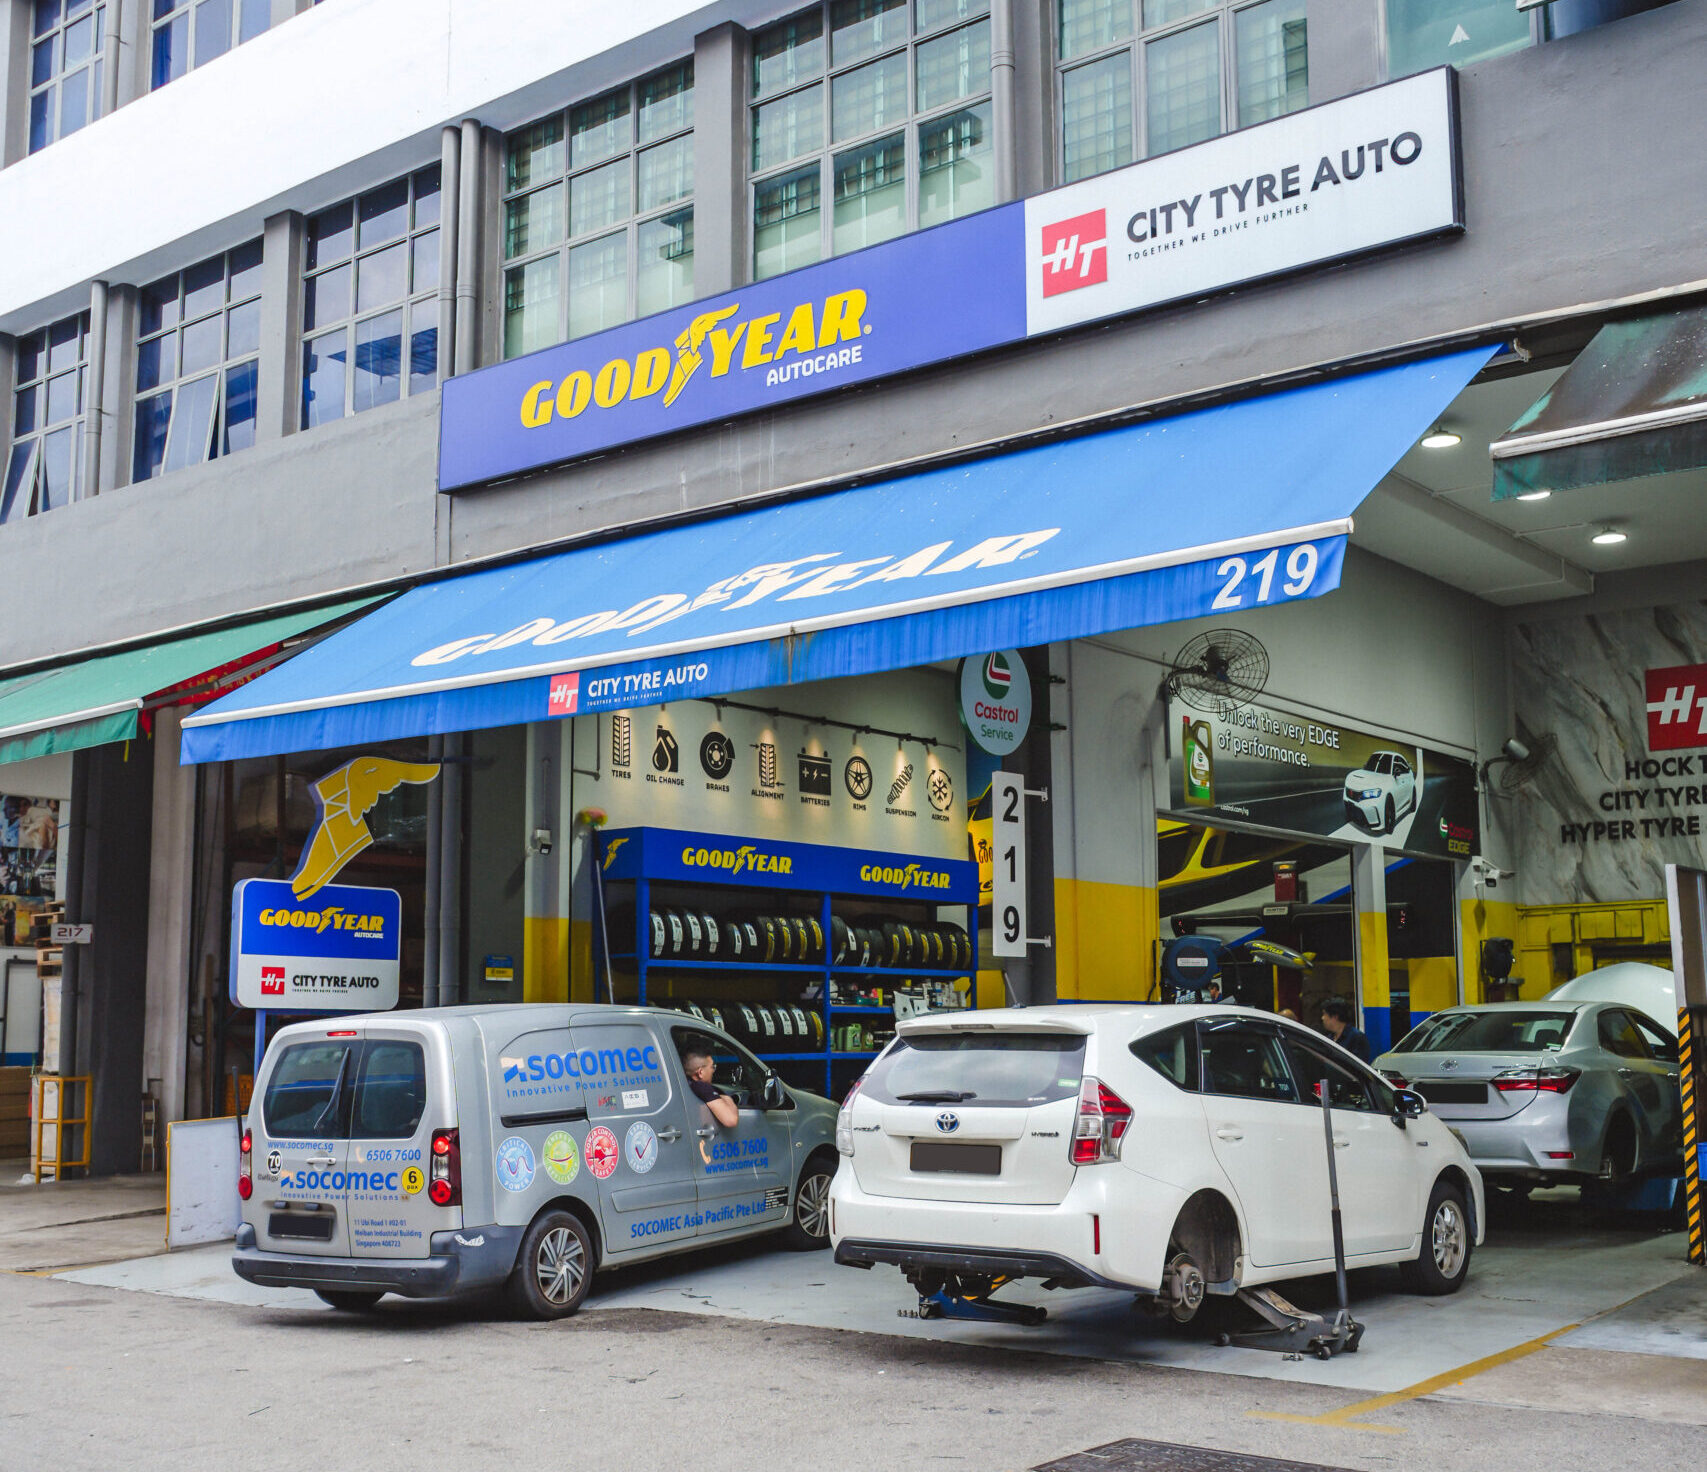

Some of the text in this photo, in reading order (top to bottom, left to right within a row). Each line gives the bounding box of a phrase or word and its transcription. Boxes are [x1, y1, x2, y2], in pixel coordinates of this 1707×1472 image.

[1126, 131, 1423, 243] CITY TYRE AUTO
[1128, 204, 1309, 261] TOGETHER WE DRIVE FURTHER
[520, 289, 868, 428] GOODYEAR
[766, 345, 863, 387] AUTOCARE
[1211, 543, 1318, 610] 219
[411, 528, 1061, 667] GOODYEAR
[588, 663, 709, 698] CITY TYRE AUTO
[974, 700, 1019, 724] Castrol
[981, 724, 1014, 741] Service
[1217, 701, 1340, 749] Unlock the very EDGE
[1218, 729, 1311, 767] of performance.
[612, 769, 632, 779] TIRES
[646, 774, 685, 786] OIL CHANGE
[1625, 756, 1694, 781] HOCK
[706, 782, 730, 793] BRAKES
[751, 789, 785, 800] ALIGNMENT
[800, 796, 831, 807] BATTERIES
[853, 803, 867, 811] RIMS
[1600, 788, 1651, 811] CITY
[885, 807, 917, 818] SUSPENSION
[931, 813, 950, 822] AIRCON
[1561, 816, 1700, 843] HYPER TYRE
[1448, 838, 1470, 854] EDGE
[682, 846, 793, 875] GOODYEAR
[1003, 785, 1020, 943] 219
[860, 864, 950, 889] GOODYEAR
[259, 907, 385, 933] GOODYEAR
[57, 927, 83, 937] 217
[292, 975, 379, 988] CITY TYRE AUTO
[527, 1046, 658, 1080] socomec
[507, 1074, 663, 1099] Innovative Power Solutions
[267, 1141, 333, 1152] www.socomec.sg
[366, 1149, 421, 1161] 6506 7600
[712, 1137, 768, 1160] 6506 7600
[270, 1154, 281, 1168] 70
[705, 1156, 769, 1174] www.socomec.sg
[296, 1171, 398, 1190] socomec
[408, 1170, 417, 1184] 6
[631, 1199, 766, 1238] SOCOMEC Asia Pacific Pte Ltd
[399, 1229, 422, 1238] Building
